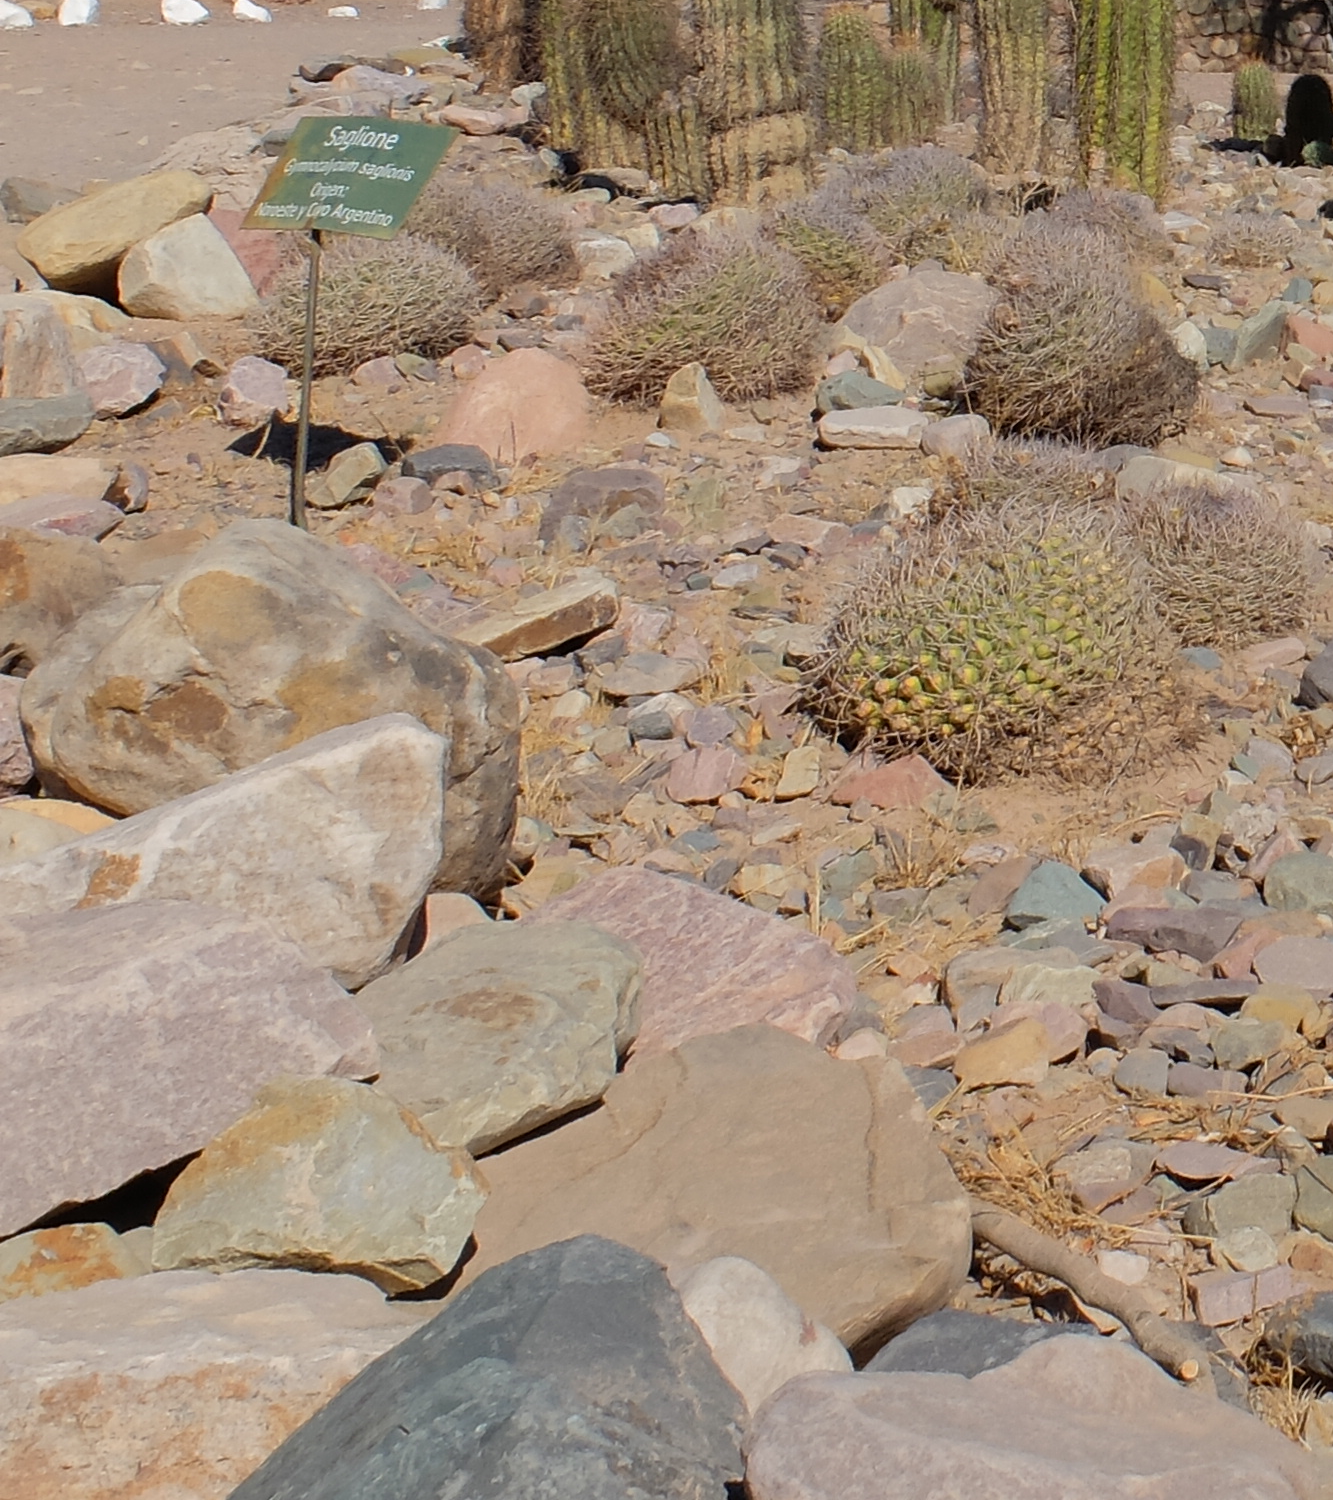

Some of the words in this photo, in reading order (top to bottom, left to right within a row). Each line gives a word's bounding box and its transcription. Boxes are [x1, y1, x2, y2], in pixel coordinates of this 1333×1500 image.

[324, 125, 399, 151] Saglione
[359, 162, 415, 181] saglionis
[331, 203, 393, 227] Argentino
